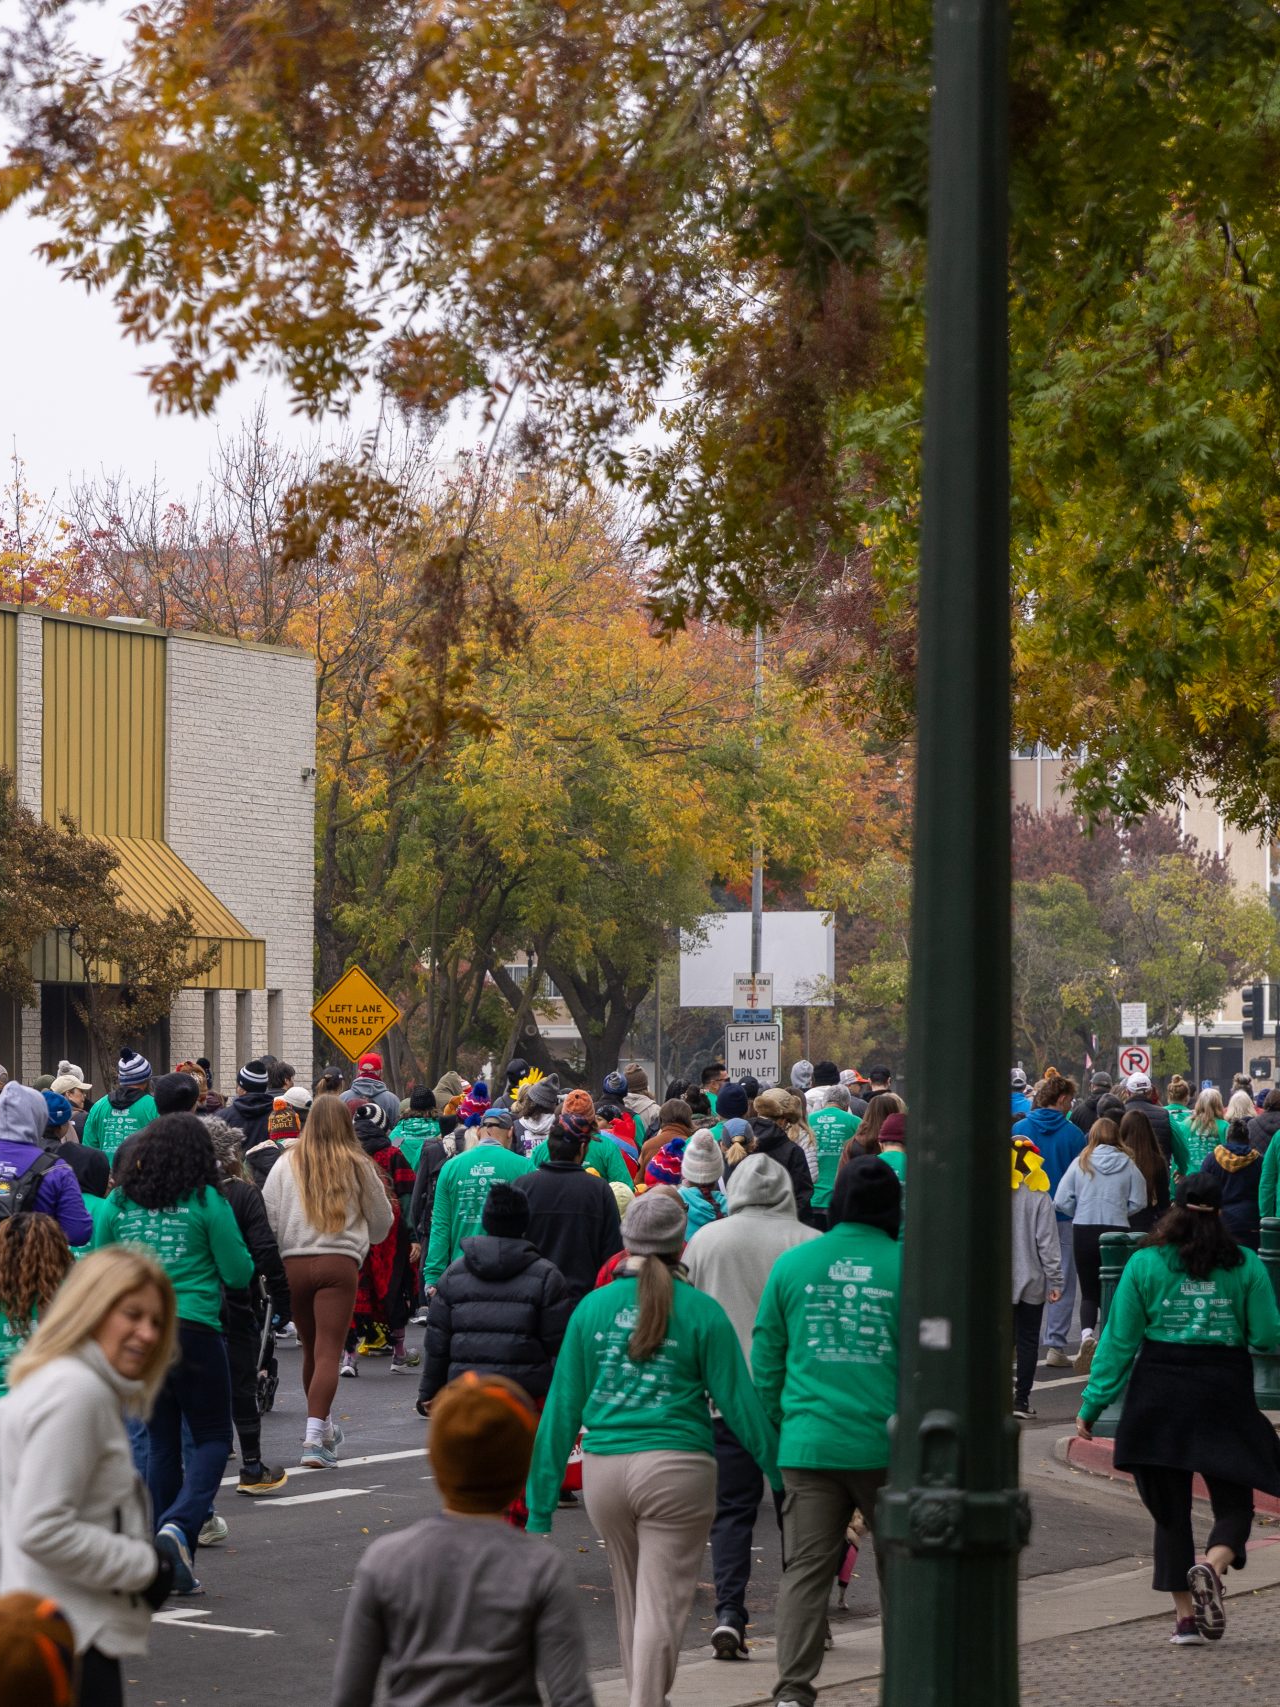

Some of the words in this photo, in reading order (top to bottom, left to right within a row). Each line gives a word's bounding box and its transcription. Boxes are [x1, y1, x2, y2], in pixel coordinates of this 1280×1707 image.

[329, 1004, 352, 1013] LEFT
[356, 1004, 382, 1013] LANE
[325, 1016, 358, 1024] TURNS
[362, 1016, 386, 1024] LEFT
[338, 1028, 373, 1036] AHEAD
[730, 1032, 749, 1042] LEFT
[755, 1032, 776, 1041] LANE
[739, 1049, 767, 1060] MUST
[731, 1068, 752, 1078] TURN
[757, 1067, 776, 1077] LEFT
[861, 1286, 894, 1299] amazon
